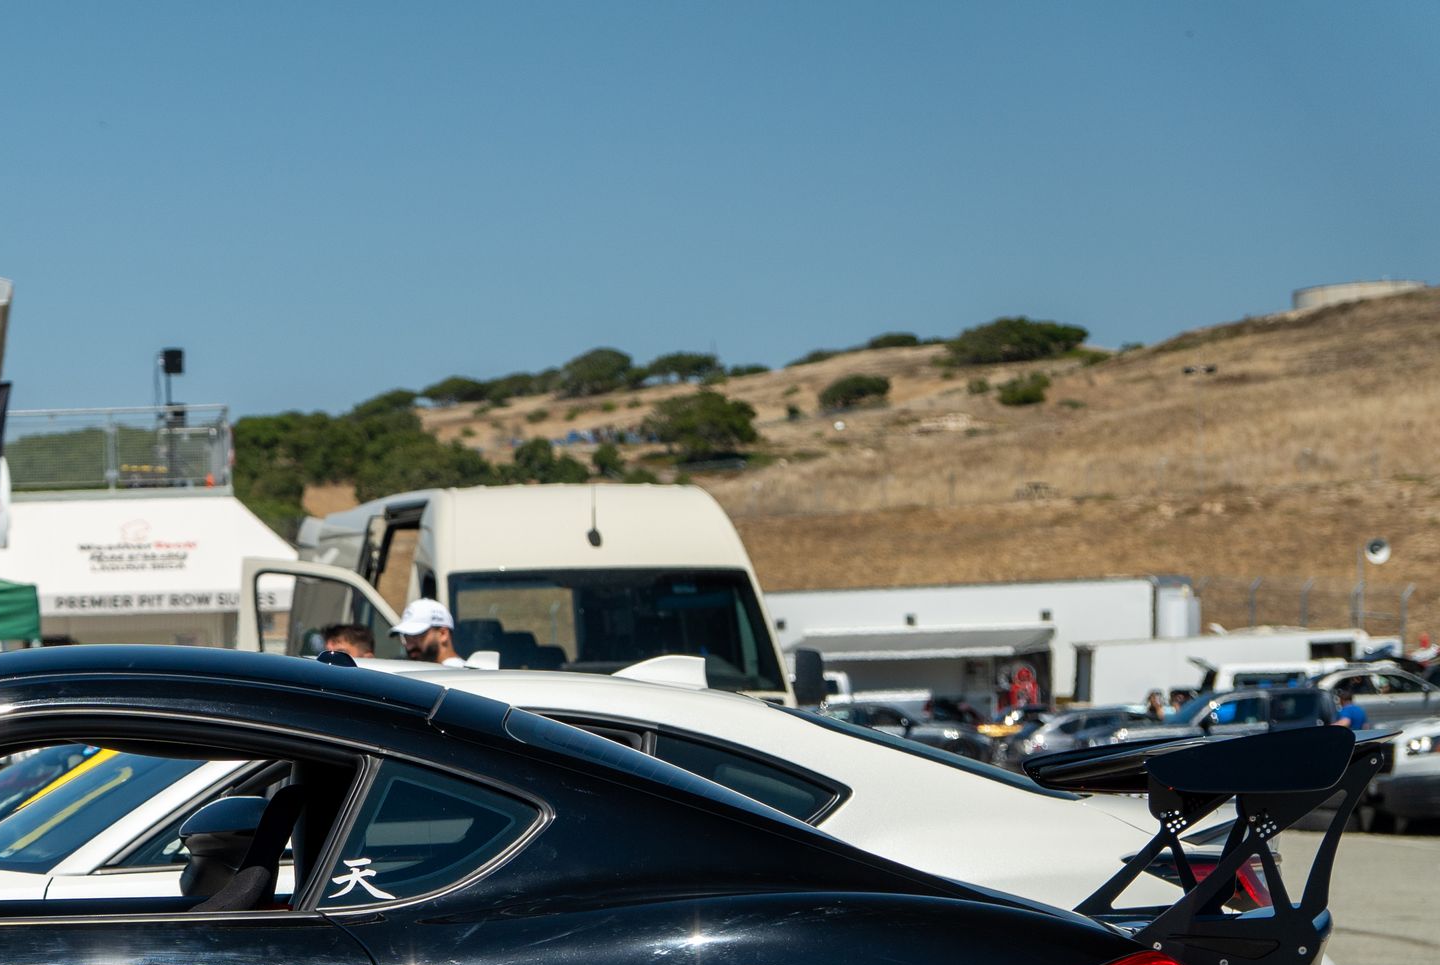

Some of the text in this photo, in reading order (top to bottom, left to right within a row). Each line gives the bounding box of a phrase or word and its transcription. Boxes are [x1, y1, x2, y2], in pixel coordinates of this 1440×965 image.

[55, 594, 132, 609] PREMIER
[138, 594, 164, 606] PIT
[170, 593, 212, 606] ROW
[328, 857, 397, 900] 天
